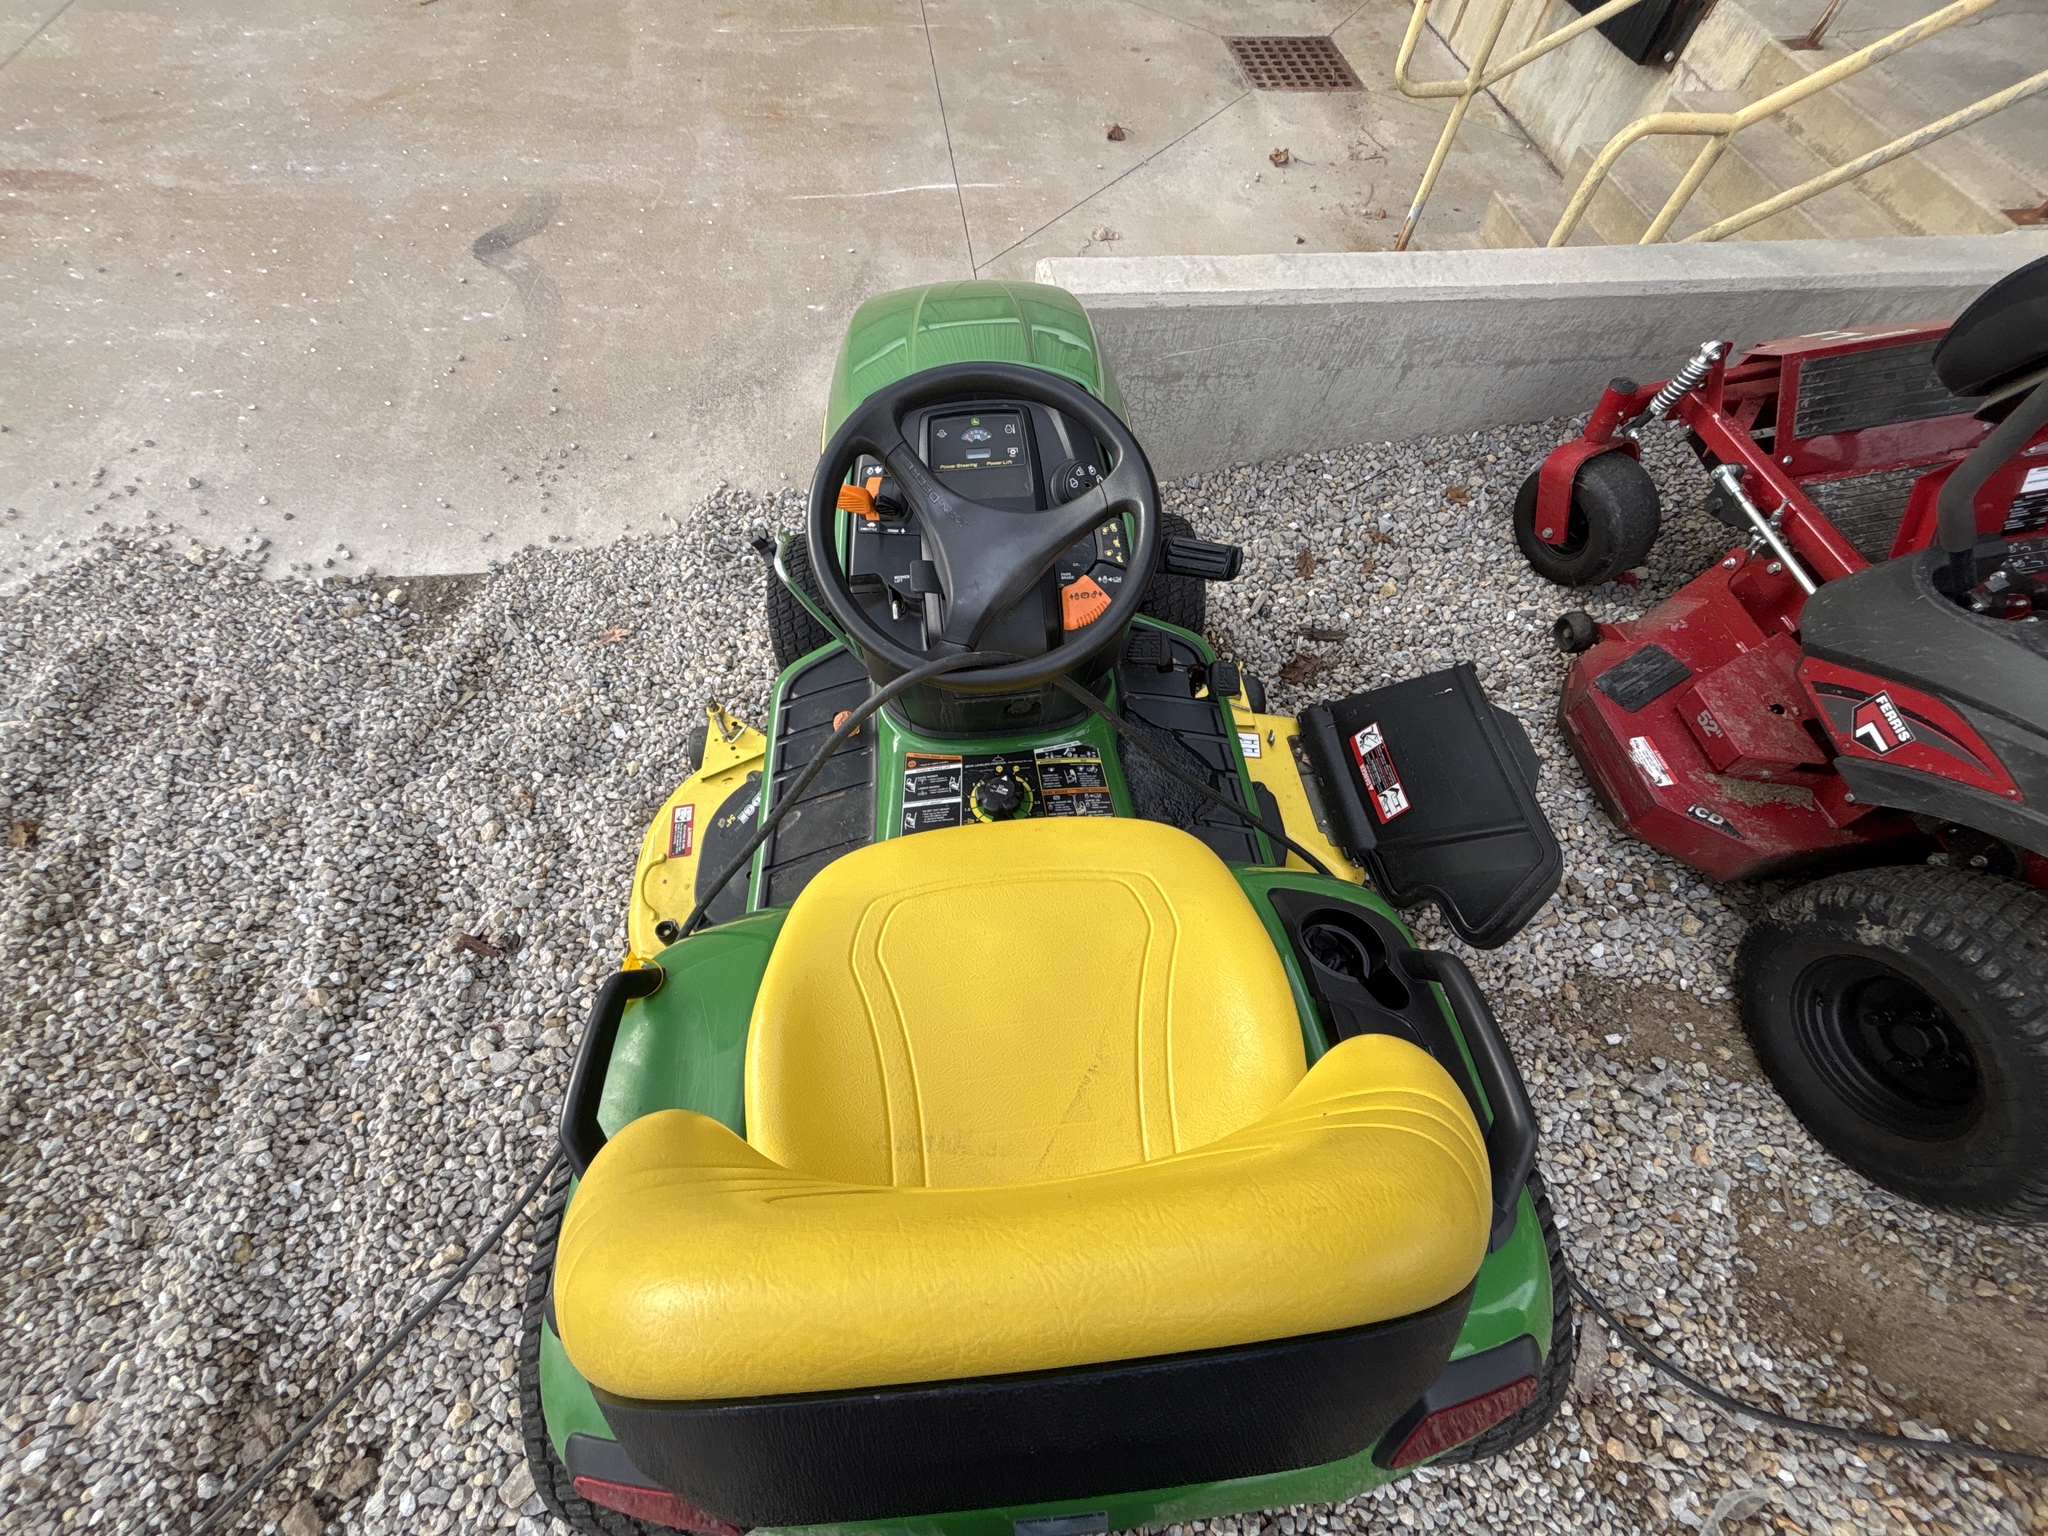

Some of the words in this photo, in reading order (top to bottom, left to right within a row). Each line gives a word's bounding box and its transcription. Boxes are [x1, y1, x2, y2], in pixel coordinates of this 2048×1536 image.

[904, 459, 940, 504] DEERE
[1697, 709, 1724, 739] 52"
[1875, 695, 1911, 742] FERRIS
